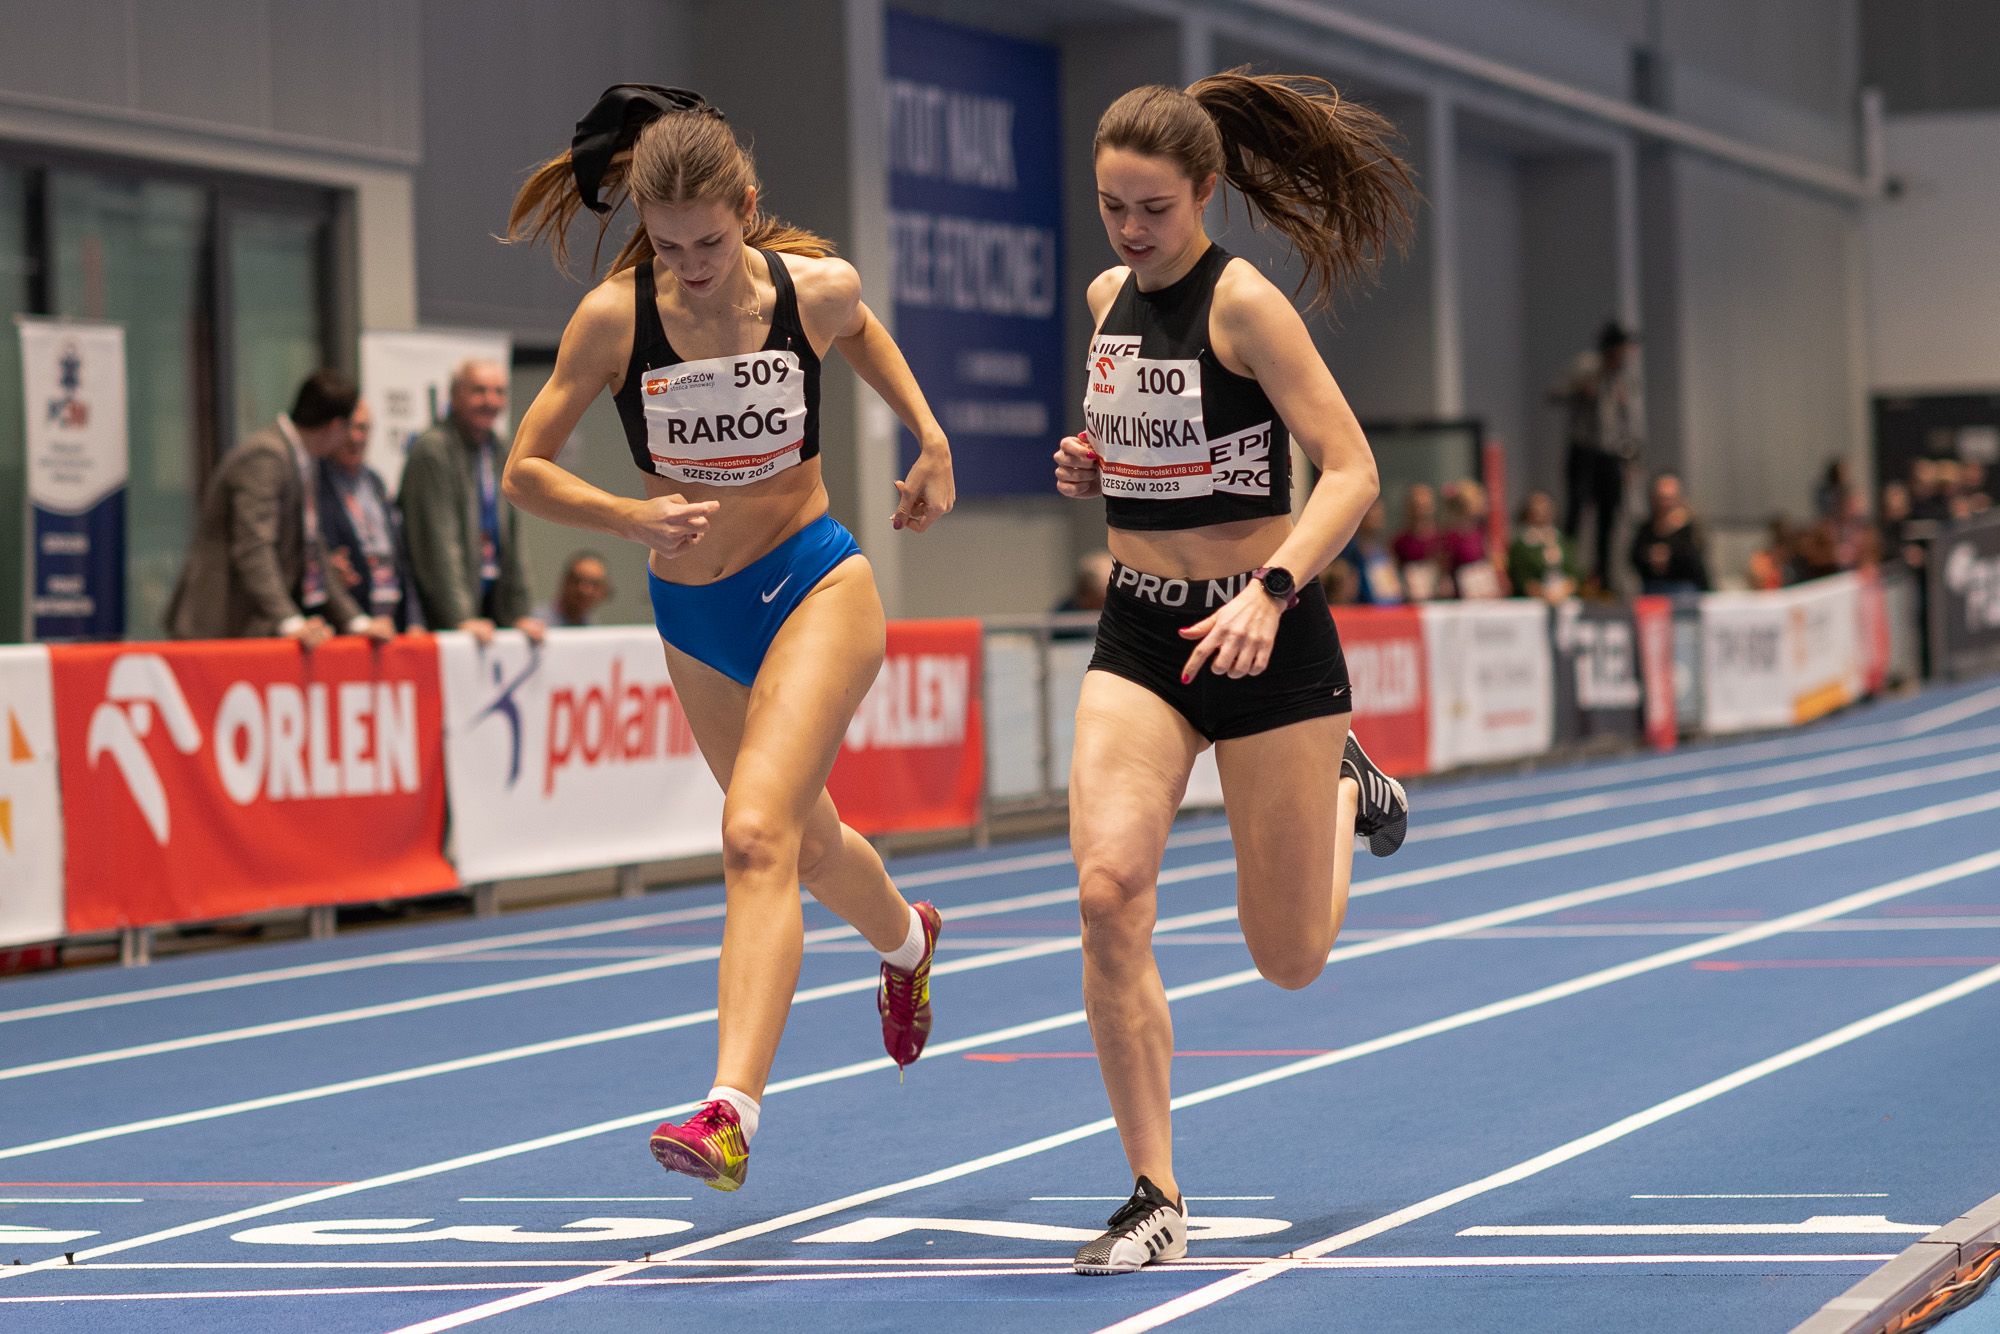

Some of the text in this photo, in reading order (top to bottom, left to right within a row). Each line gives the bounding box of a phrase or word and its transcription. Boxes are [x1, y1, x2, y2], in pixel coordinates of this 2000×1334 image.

[670, 372, 715, 386] rzeszów
[734, 358, 789, 388] 509
[1137, 367, 1185, 395] 100
[667, 404, 788, 445] RARÓG
[682, 462, 775, 481] RZESZÓW 2023
[1151, 468, 1172, 476] Polski
[1174, 467, 1187, 475] U18
[1189, 465, 1204, 473] U20
[1149, 482, 1180, 492] 2023
[1116, 566, 1189, 607] PRO
[1205, 570, 1258, 608] NI
[213, 679, 421, 806] ORLEN
